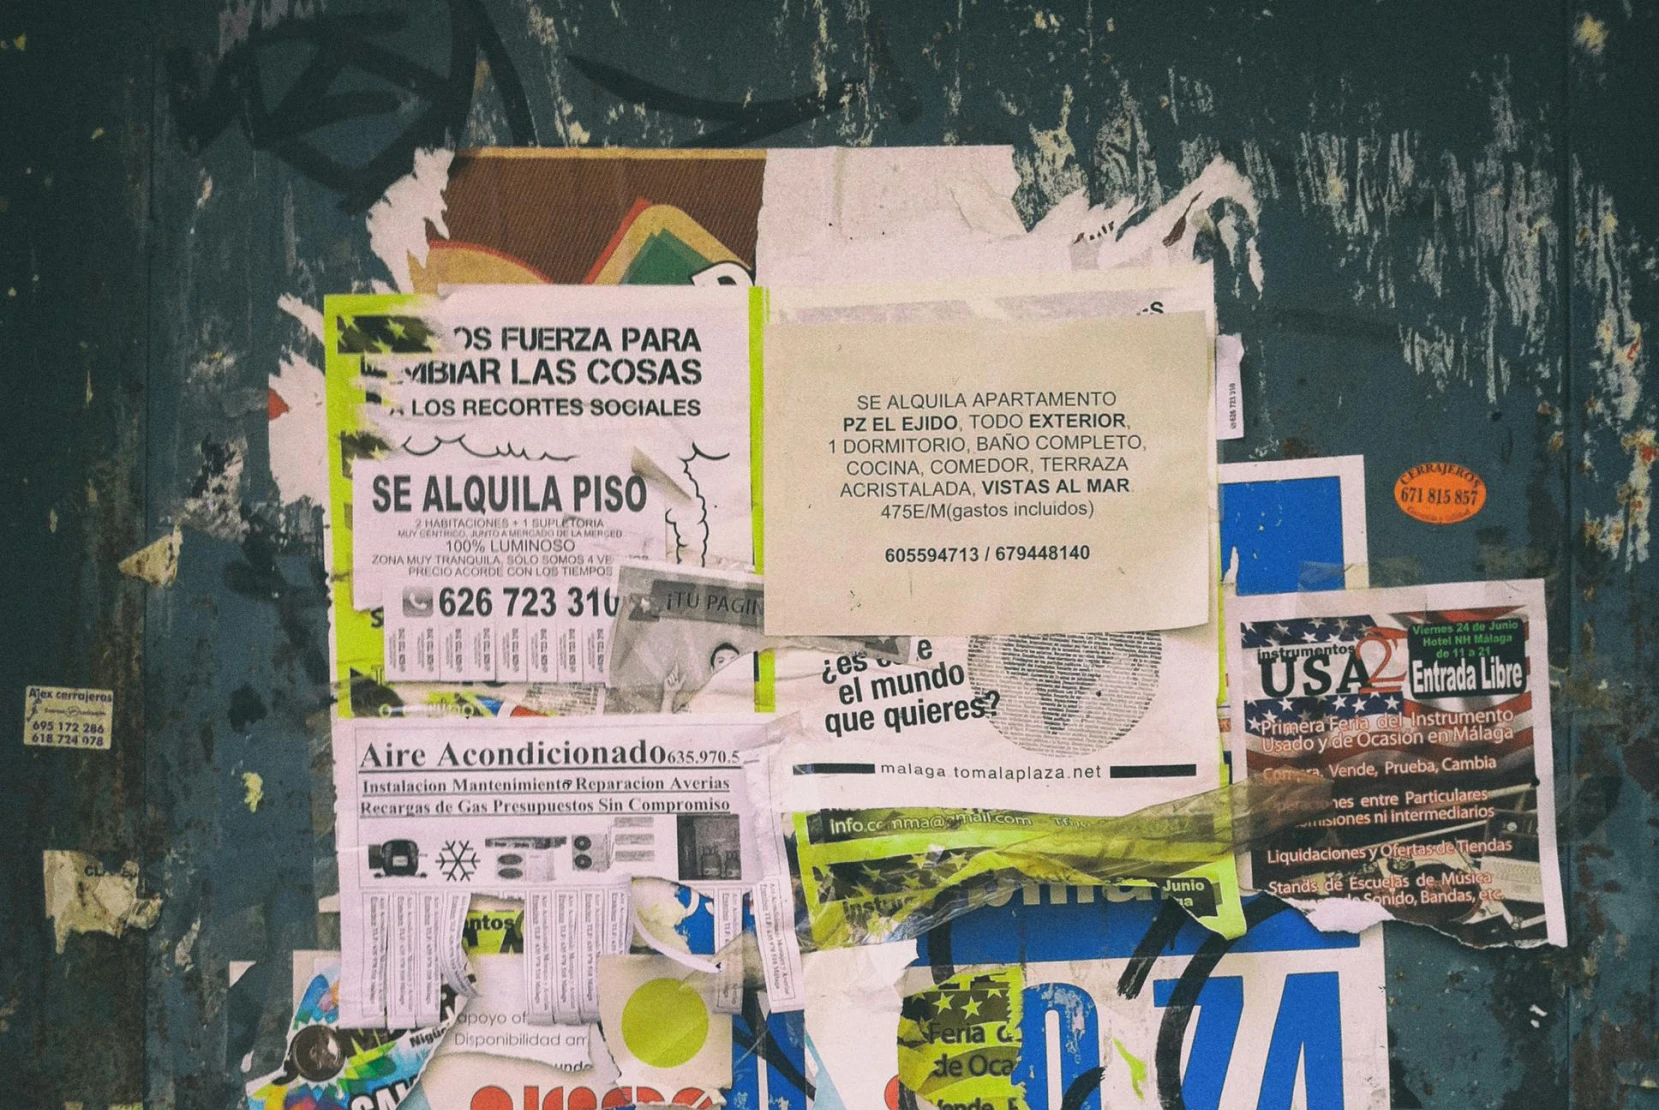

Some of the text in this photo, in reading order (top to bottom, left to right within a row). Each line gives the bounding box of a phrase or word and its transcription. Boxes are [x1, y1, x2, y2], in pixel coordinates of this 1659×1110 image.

[502, 327, 611, 352] FUERZA
[622, 328, 701, 352] PARA
[512, 358, 577, 385] LAS
[587, 357, 702, 385] COSAS
[412, 399, 701, 417] LOS RECORTES SOCIALES
[857, 392, 1117, 410] SE ALQUILA APARTAMENTO
[844, 414, 1131, 432] PZ EL EJIDO, TODO EXTERIOR,
[828, 434, 1147, 455] 1 DORMITORIO, BAÑO COMPLETO,
[846, 456, 1129, 478] COCINA, COMEDOR, TERRAZA
[1400, 464, 1481, 488] CERRAJEROS
[372, 474, 647, 515] SE ALQUILA PISO
[840, 480, 976, 498] ACRISTALADA,
[982, 479, 1050, 496] VISTAS
[1056, 478, 1082, 494] AL
[1402, 487, 1478, 506] 671 815 857
[1014, 500, 1095, 520] incluidos)
[446, 539, 575, 554] 100% LUMINOSO
[885, 545, 1091, 564] 605594713 / 679448140
[439, 586, 493, 617] 626
[503, 586, 557, 617] 723
[1412, 620, 1519, 635] Viernes 24 de Junio
[1423, 634, 1513, 647] Hotel NH Málaga
[1258, 644, 1356, 660] instrumentos
[838, 661, 965, 705] el mundo
[1412, 656, 1523, 693] Entrada Libre
[824, 690, 1001, 738] que quieres?
[1261, 709, 1514, 736] Primera Feria del Instrumento
[33, 721, 54, 731] 695
[58, 722, 79, 732] 172
[1262, 724, 1514, 754] Usado y de Ocasión en Málaga
[361, 742, 427, 769] Aire
[438, 739, 666, 768] Acondicionado
[1329, 757, 1497, 779] Vende, Prueba, Cambia
[363, 779, 447, 793] Instalacion
[576, 776, 665, 795] Reparacion
[670, 776, 731, 791] Averias
[361, 796, 731, 817] Recargas de Gas Presupuestos Sin Compromiso
[1268, 838, 1513, 865] Liquidaciones y Ofertas de Tiendas
[1162, 880, 1205, 894] Junio
[1268, 870, 1493, 895] Stands de Escuelas de Música
[1421, 888, 1477, 904] Bandas,
[458, 1012, 507, 1027] apoyo
[454, 1032, 561, 1048] Disponibilidad
